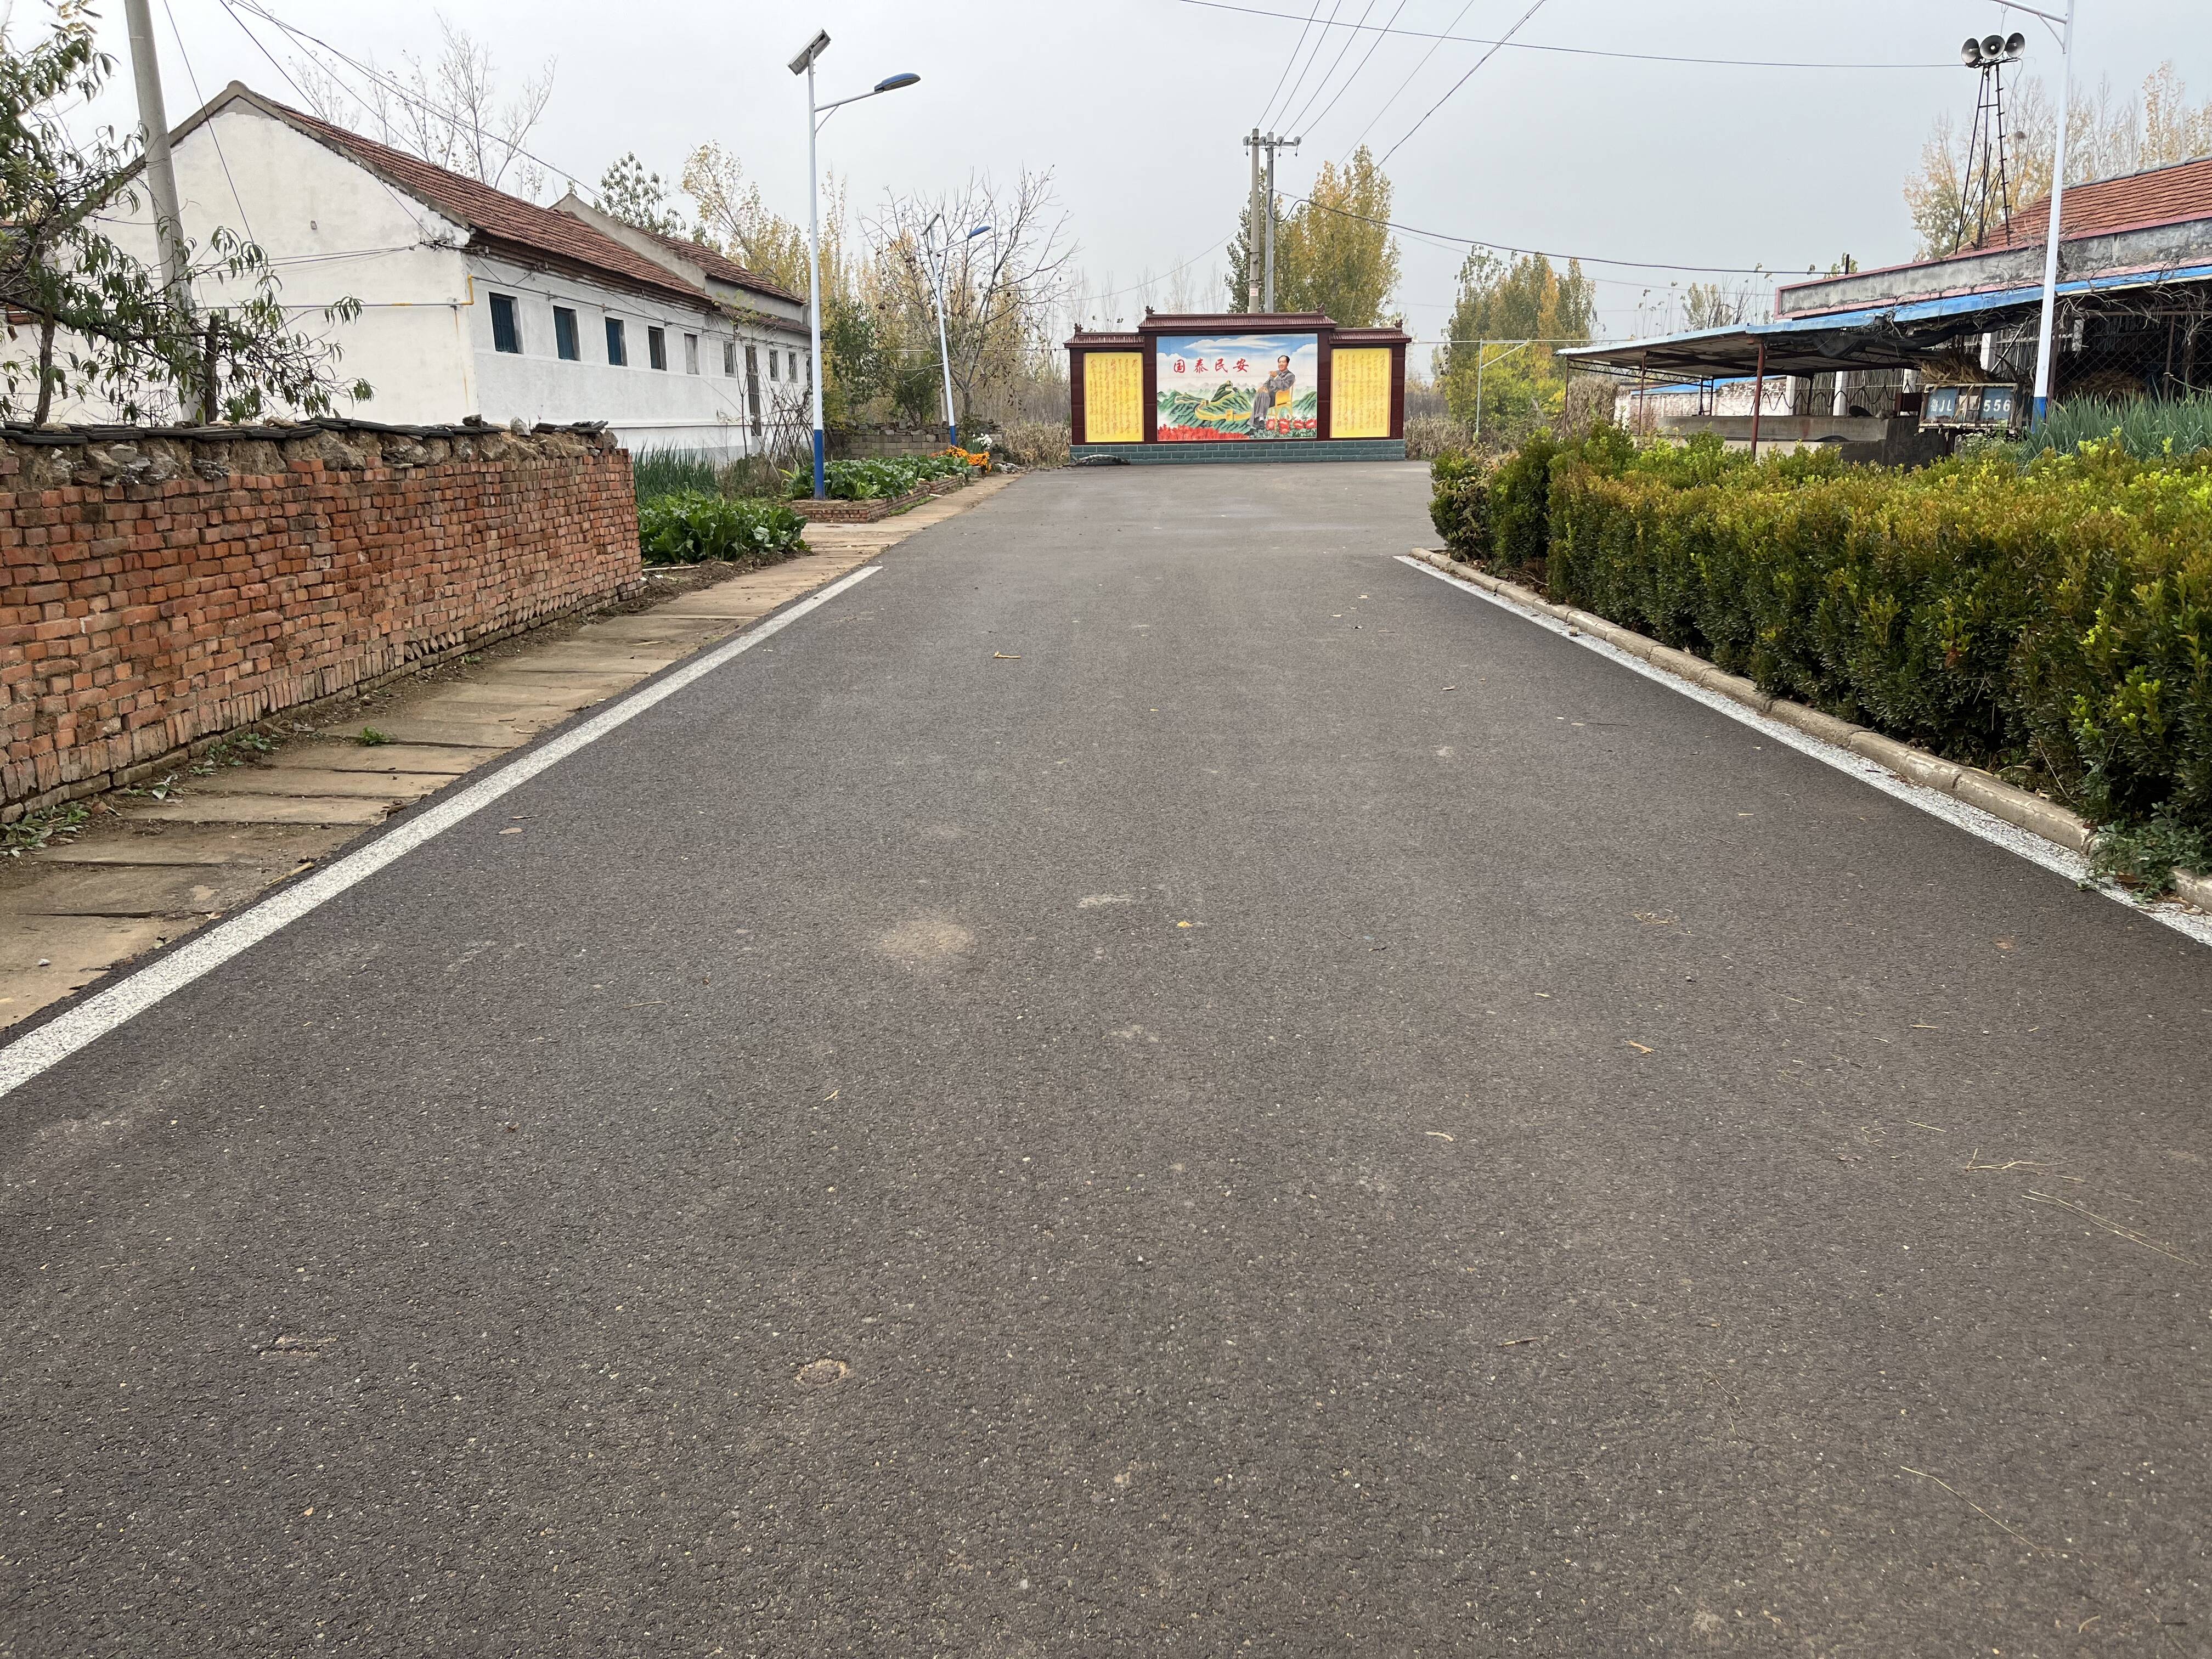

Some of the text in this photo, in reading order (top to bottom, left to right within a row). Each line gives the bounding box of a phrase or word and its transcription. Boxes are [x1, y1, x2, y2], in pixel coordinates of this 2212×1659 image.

[1174, 357, 1249, 373] 国泰民安
[1983, 399, 2011, 412] 556
